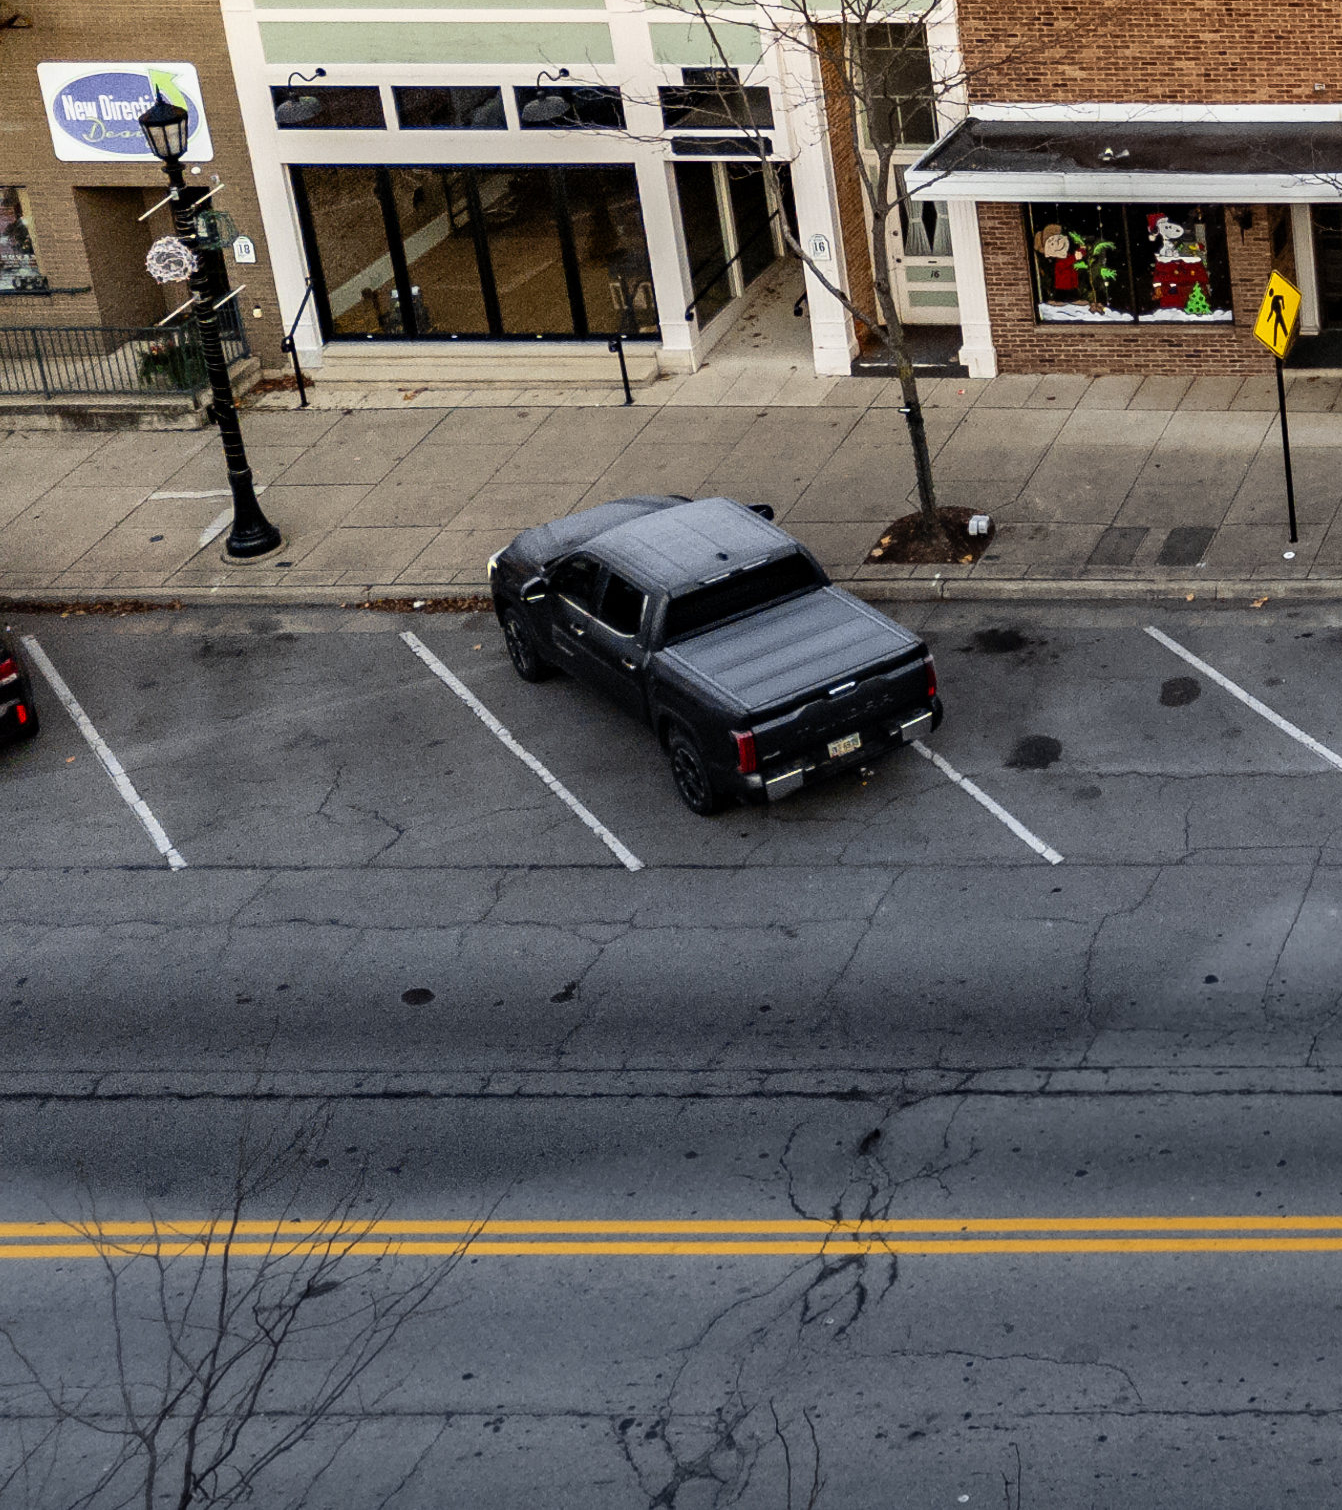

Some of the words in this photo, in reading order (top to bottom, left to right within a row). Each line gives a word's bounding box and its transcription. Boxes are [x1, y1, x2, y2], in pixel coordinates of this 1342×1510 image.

[61, 95, 98, 121] New
[237, 244, 251, 255] 18
[814, 241, 826, 252] 16
[930, 270, 940, 279] 16
